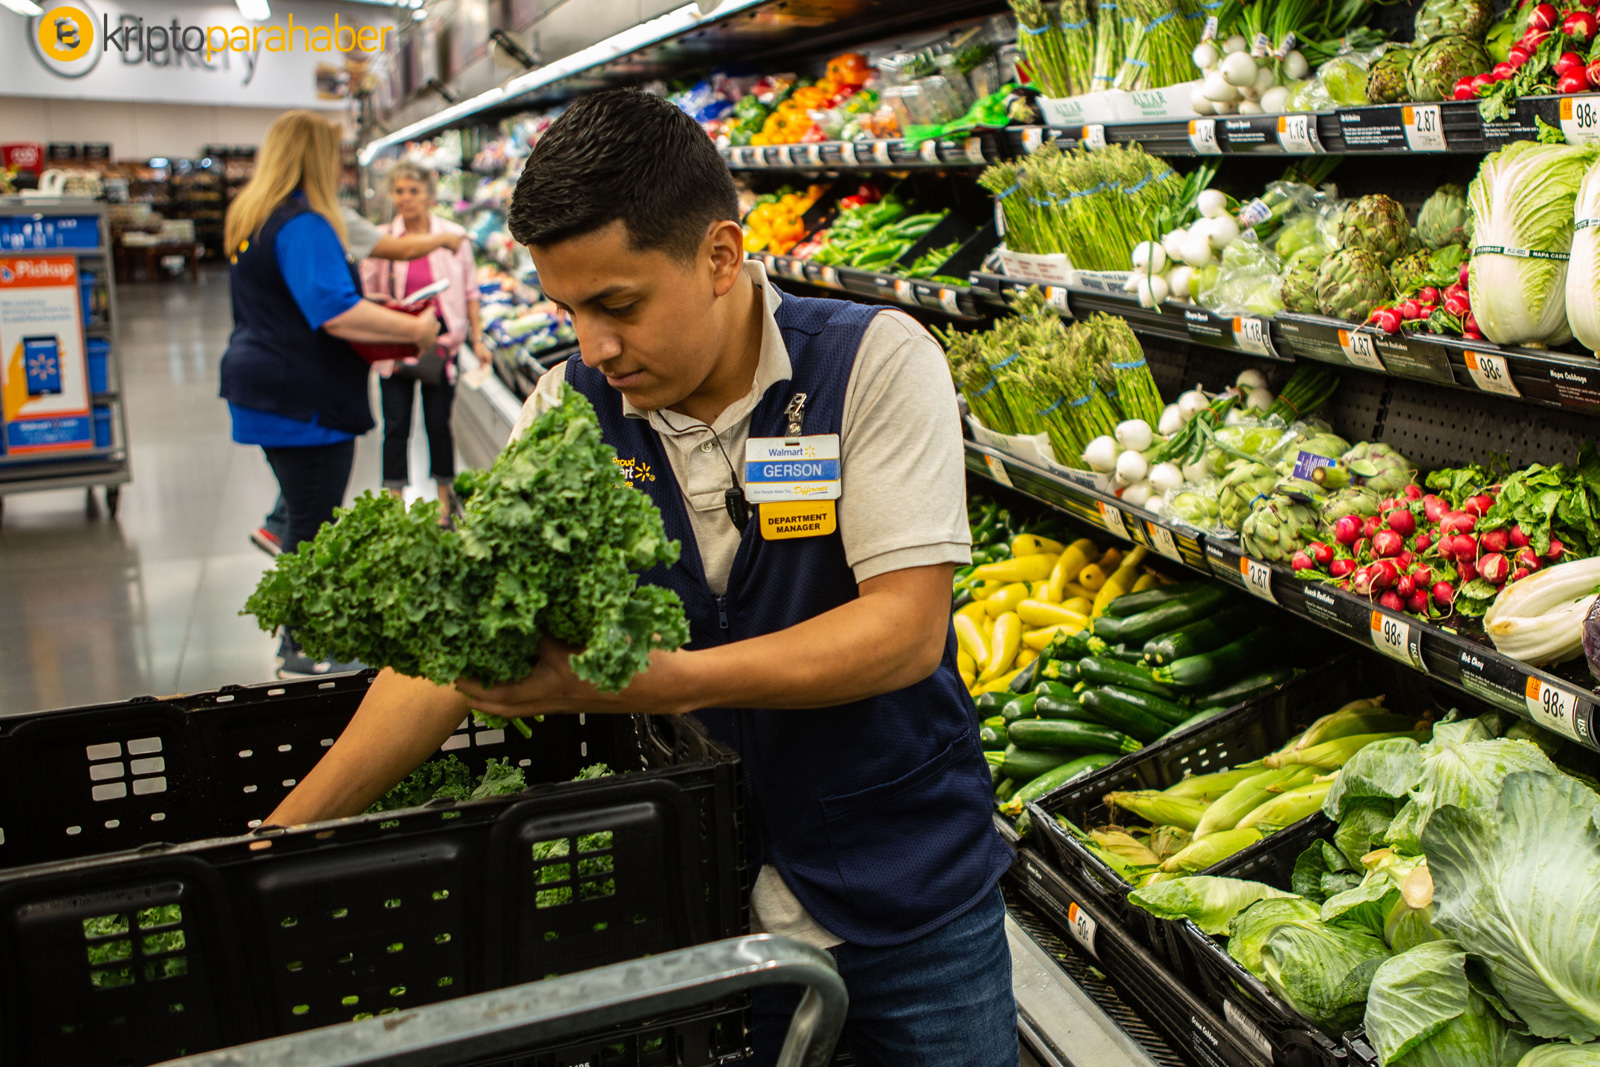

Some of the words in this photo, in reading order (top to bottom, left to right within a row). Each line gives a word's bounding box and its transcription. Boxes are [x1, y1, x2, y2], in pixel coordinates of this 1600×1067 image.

[1416, 110, 1436, 132] 2.87
[1576, 103, 1597, 128] 98¢
[1288, 119, 1305, 140] 1.18
[1533, 251, 1549, 259] NAPA
[16, 260, 75, 281] Pickup
[1351, 335, 1372, 357] 2.87
[1480, 357, 1502, 381] 98¢
[1550, 370, 1564, 379] Napa
[1564, 372, 1587, 384] Cabbage
[768, 448, 803, 457] Walmart
[763, 464, 822, 477] GERSON
[794, 485, 828, 496] Difference
[768, 513, 828, 525] DEPARTMENT
[776, 523, 820, 533] MANAGER
[1250, 564, 1267, 590] 2.87
[1384, 620, 1402, 648] 98¢
[1461, 651, 1471, 663] Bok
[1472, 656, 1484, 670] Choy
[1543, 687, 1565, 720] 98¢
[1577, 718, 1588, 736] USA
